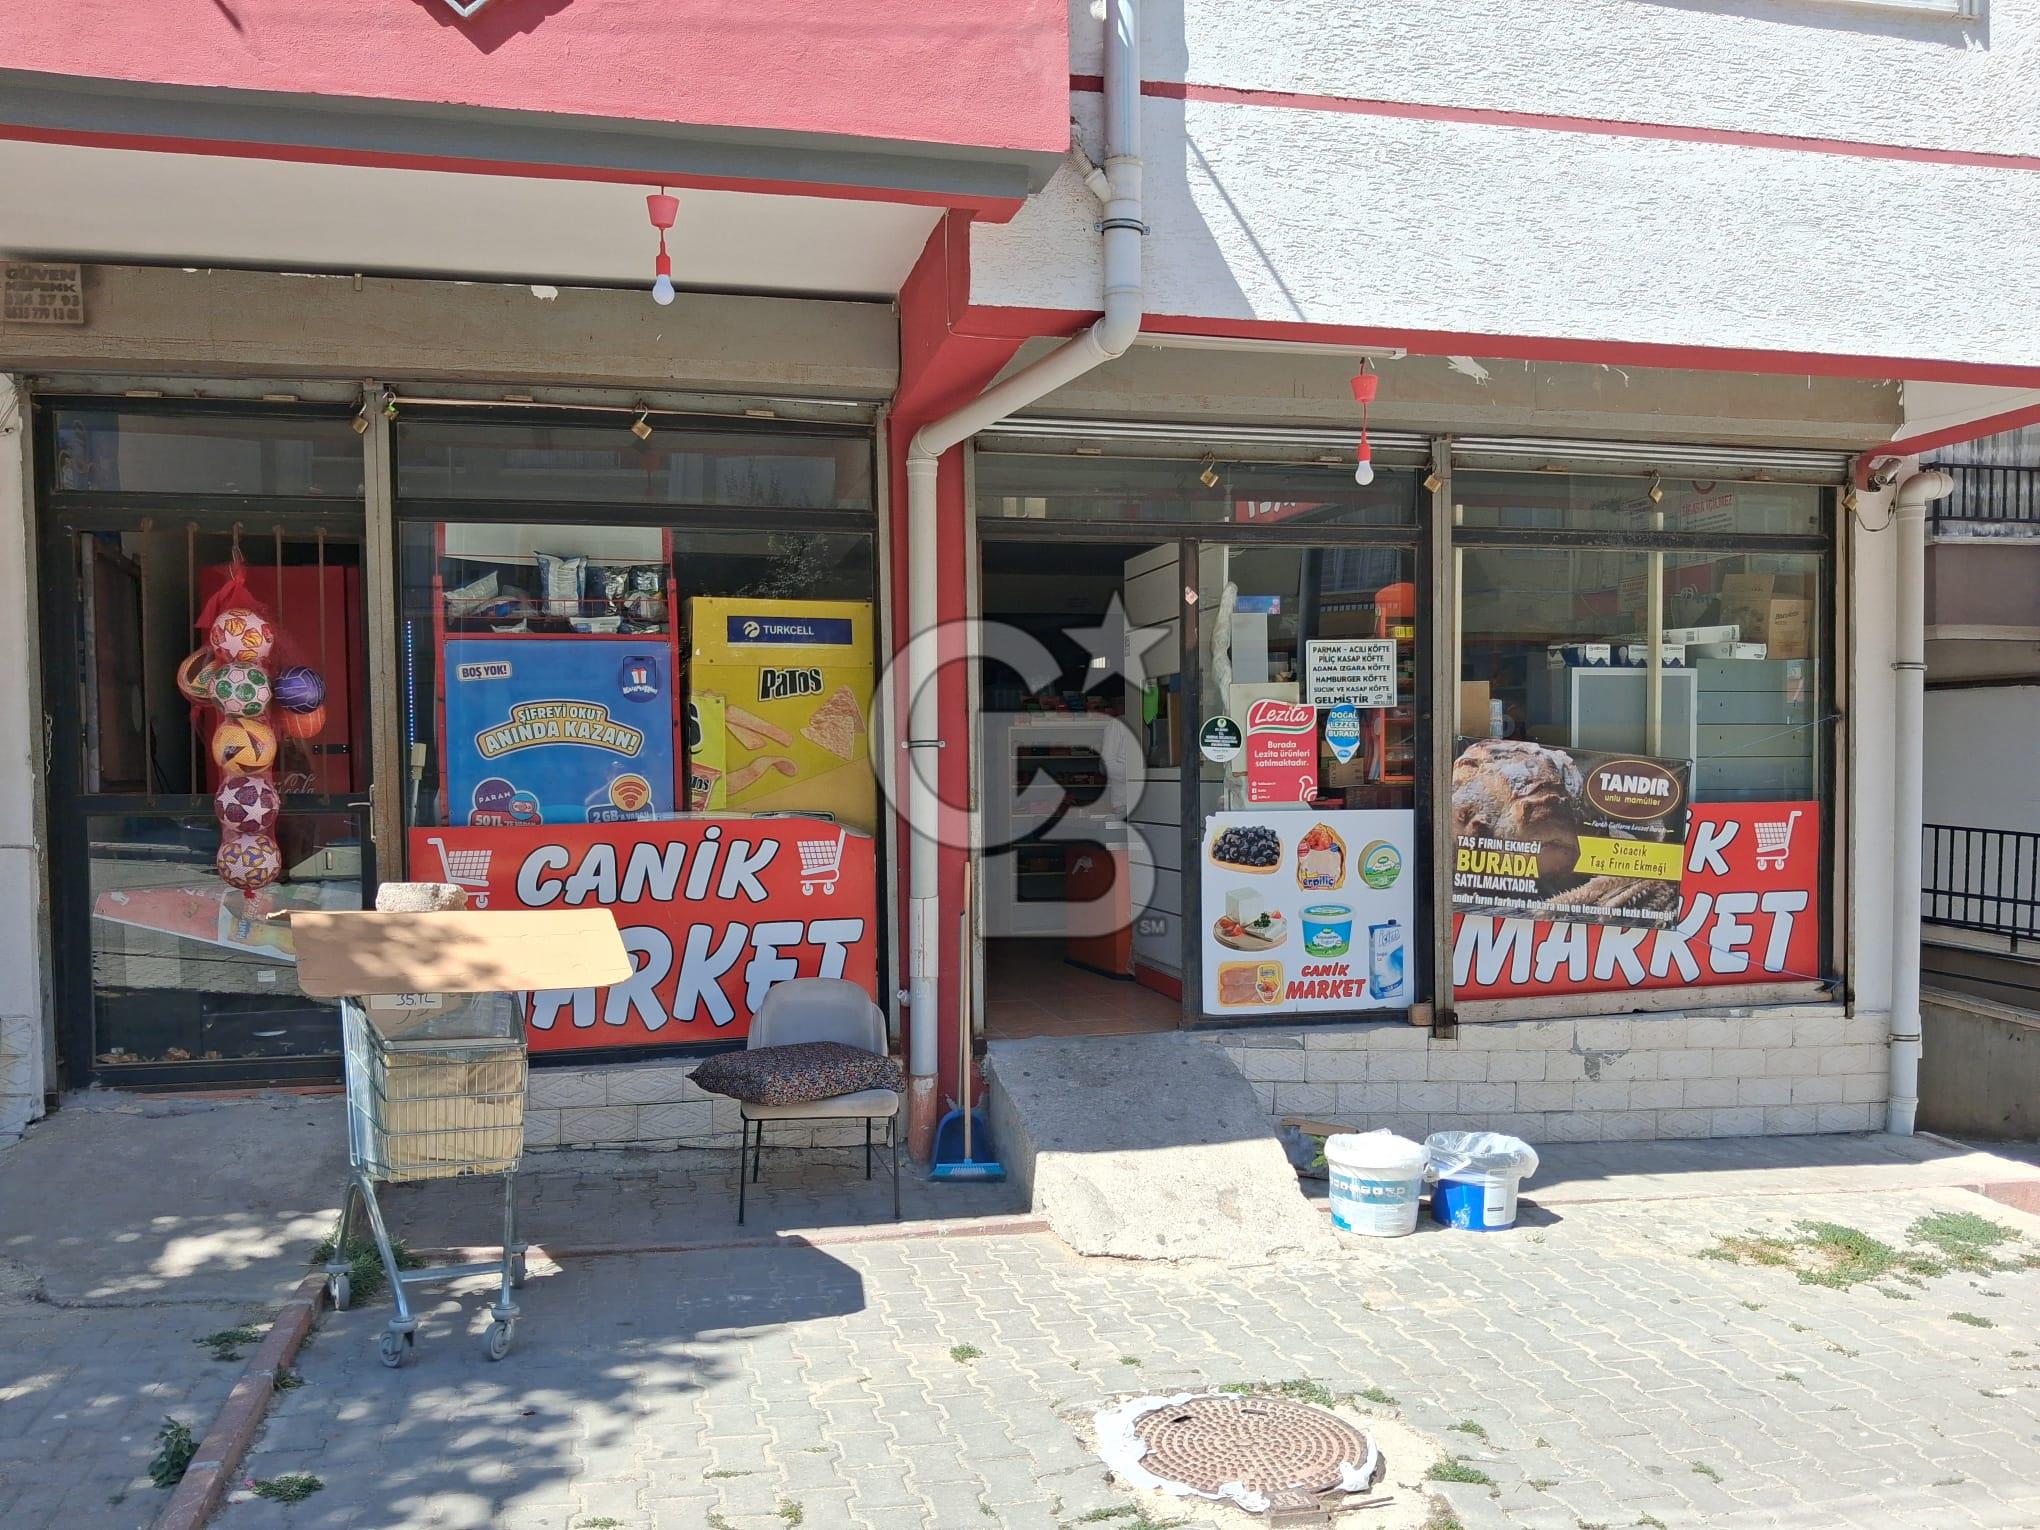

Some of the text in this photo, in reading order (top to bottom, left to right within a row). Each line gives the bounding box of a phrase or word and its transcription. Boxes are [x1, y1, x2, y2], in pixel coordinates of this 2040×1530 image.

[5, 265, 76, 281] GÜVEN
[762, 625, 815, 636] TURKCELL
[1312, 646, 1341, 654] PARMAK
[1368, 643, 1390, 652] KÖFTE
[1318, 654, 1336, 664] PİLİÇ
[1362, 653, 1384, 662] KÖFTE
[462, 664, 508, 679] BOŞ YOK!
[1367, 663, 1391, 671] KÖFTE
[1315, 673, 1387, 683] HAMBURGER KÖFTE
[1369, 684, 1390, 692] KÖFTE
[518, 704, 604, 724] ŞİFREYİ OKUT
[1255, 701, 1309, 724] Lezita
[484, 720, 639, 752] ANINDA KAZAN!
[1267, 740, 1297, 749] Burada
[1254, 749, 1310, 758] Lezita ürünleri
[1255, 759, 1310, 767] satılmaktadır.
[1600, 773, 1670, 796] TANDIR
[1604, 793, 1621, 802] unlu
[592, 811, 601, 823] 2
[1457, 835, 1542, 854] TAŞ FIRIN EKMEĞİ
[1612, 842, 1648, 857] Sıcacık
[516, 825, 780, 907] CANİK
[1456, 849, 1539, 878] BURADA
[1590, 855, 1667, 876] Taş Fırın Ekmeği
[1454, 873, 1539, 894] SATILMAKTADIR.
[1453, 890, 1808, 987] MARKET
[1301, 962, 1350, 977] CANİK
[1285, 978, 1366, 1000] MARKET
